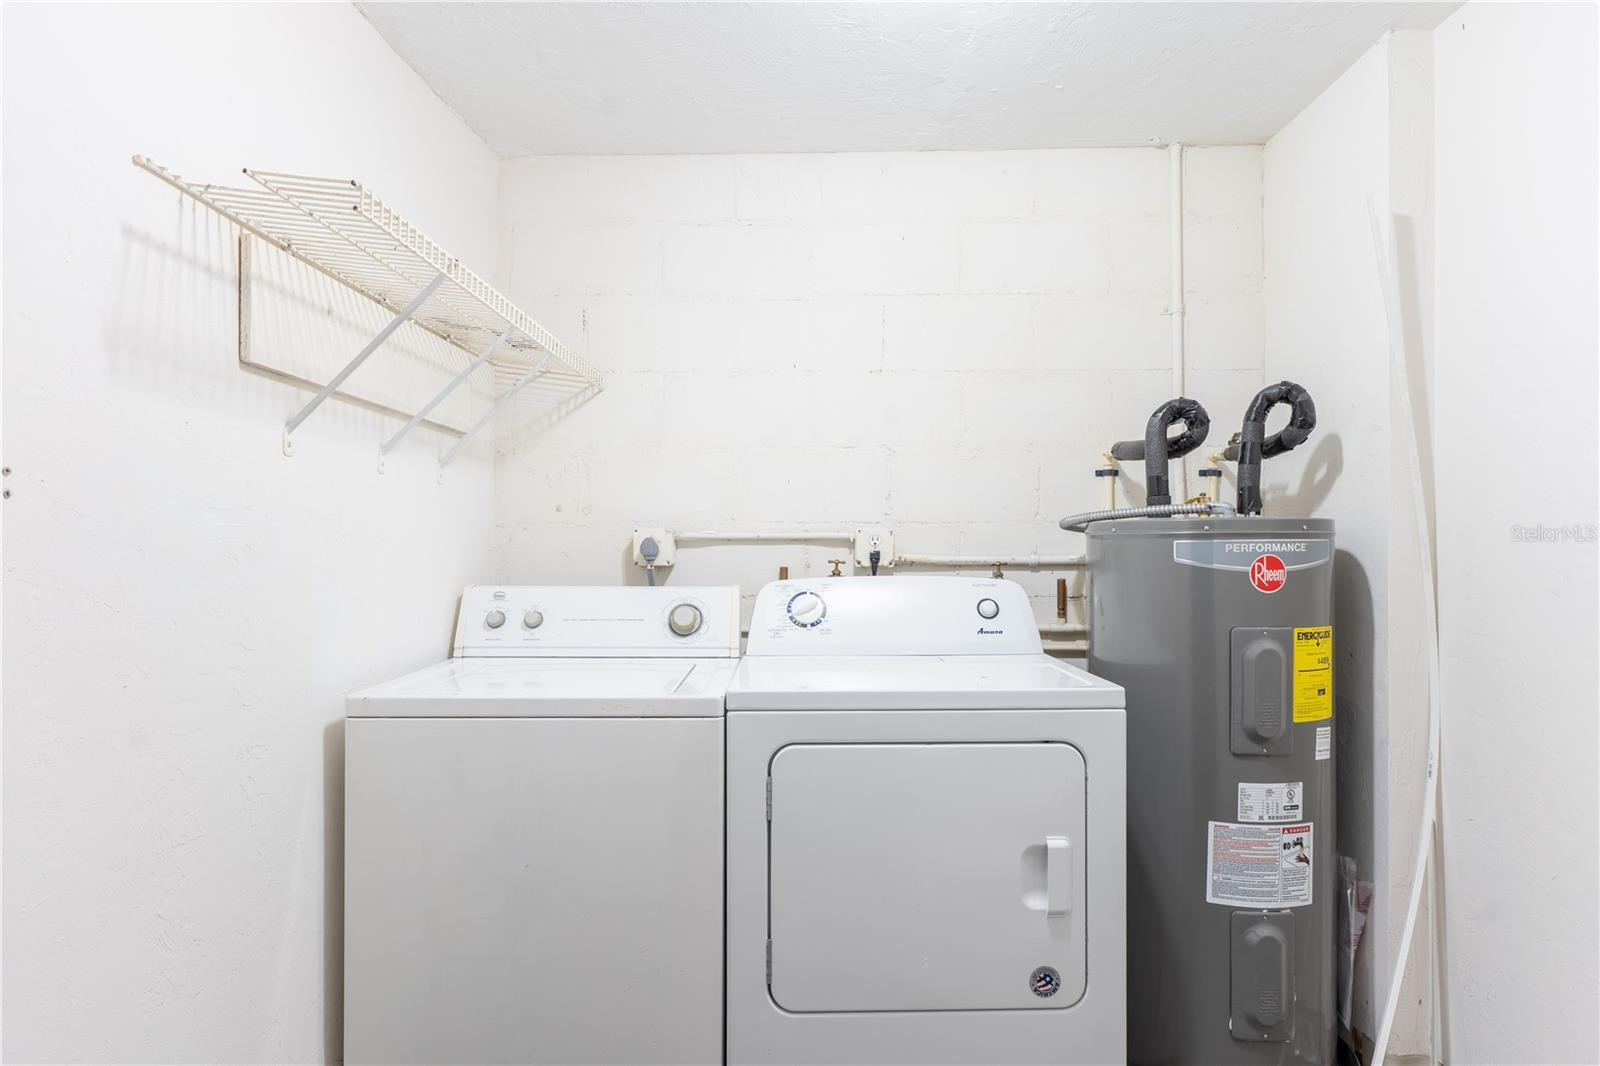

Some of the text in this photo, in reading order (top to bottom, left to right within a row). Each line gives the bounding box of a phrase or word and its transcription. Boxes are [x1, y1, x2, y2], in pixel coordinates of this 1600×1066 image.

[1225, 543, 1307, 553] PERFORMANCE
[1254, 556, 1285, 587] Rheem
[977, 627, 1004, 635] Amana
